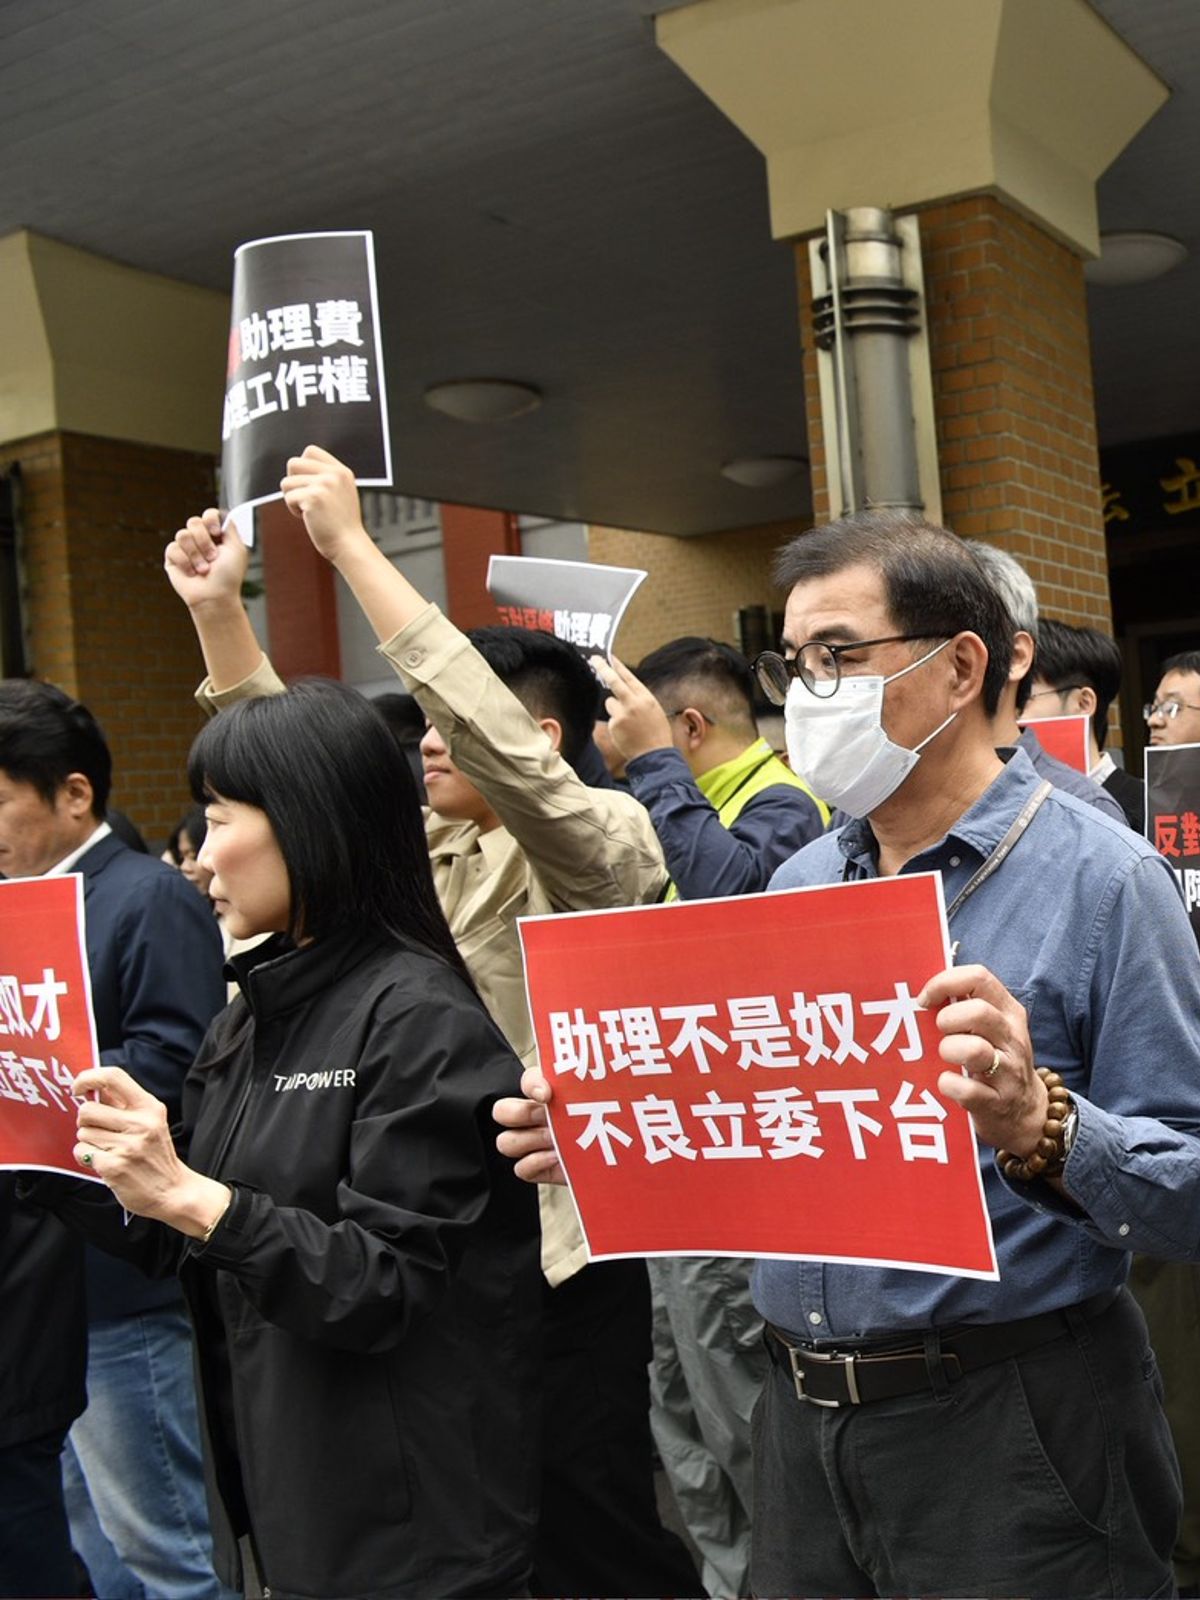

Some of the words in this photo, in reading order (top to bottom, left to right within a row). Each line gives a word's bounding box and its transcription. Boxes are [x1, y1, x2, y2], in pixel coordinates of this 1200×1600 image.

[229, 300, 364, 370] 助理費
[222, 355, 371, 441] 理工作權
[549, 982, 928, 1081] 助理不是奴才
[566, 1080, 949, 1166] 不良立委下台
